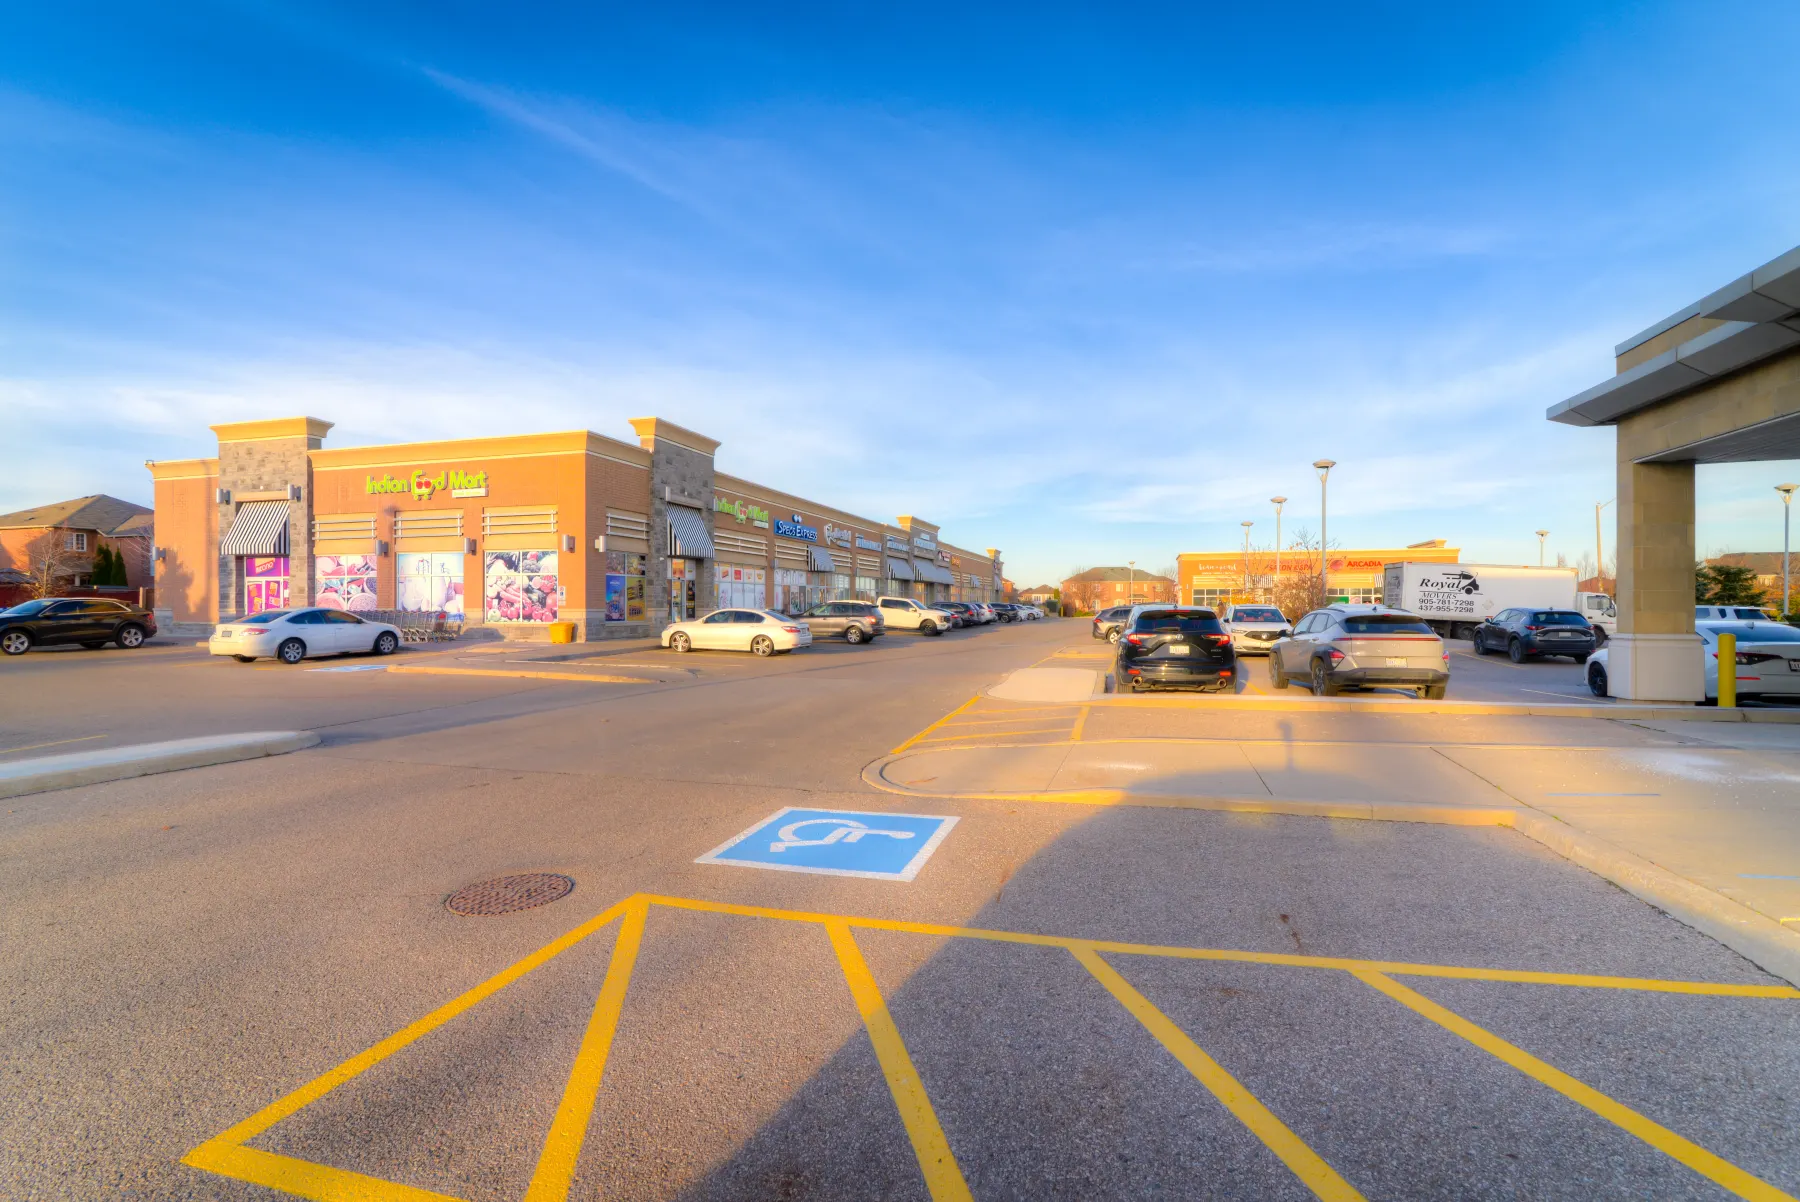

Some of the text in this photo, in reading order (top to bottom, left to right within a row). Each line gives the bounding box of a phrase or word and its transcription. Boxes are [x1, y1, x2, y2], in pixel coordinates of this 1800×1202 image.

[366, 473, 409, 494] Indian
[449, 469, 487, 489] Mart
[778, 520, 796, 537] SPECS
[796, 525, 818, 540] EXPRESS
[1346, 560, 1383, 568] ARCADIA
[1420, 578, 1462, 591] Royal
[1421, 592, 1458, 600] MOVERS
[1418, 598, 1475, 607] 905-781-7298
[1418, 605, 1474, 614] 437-955-7298
